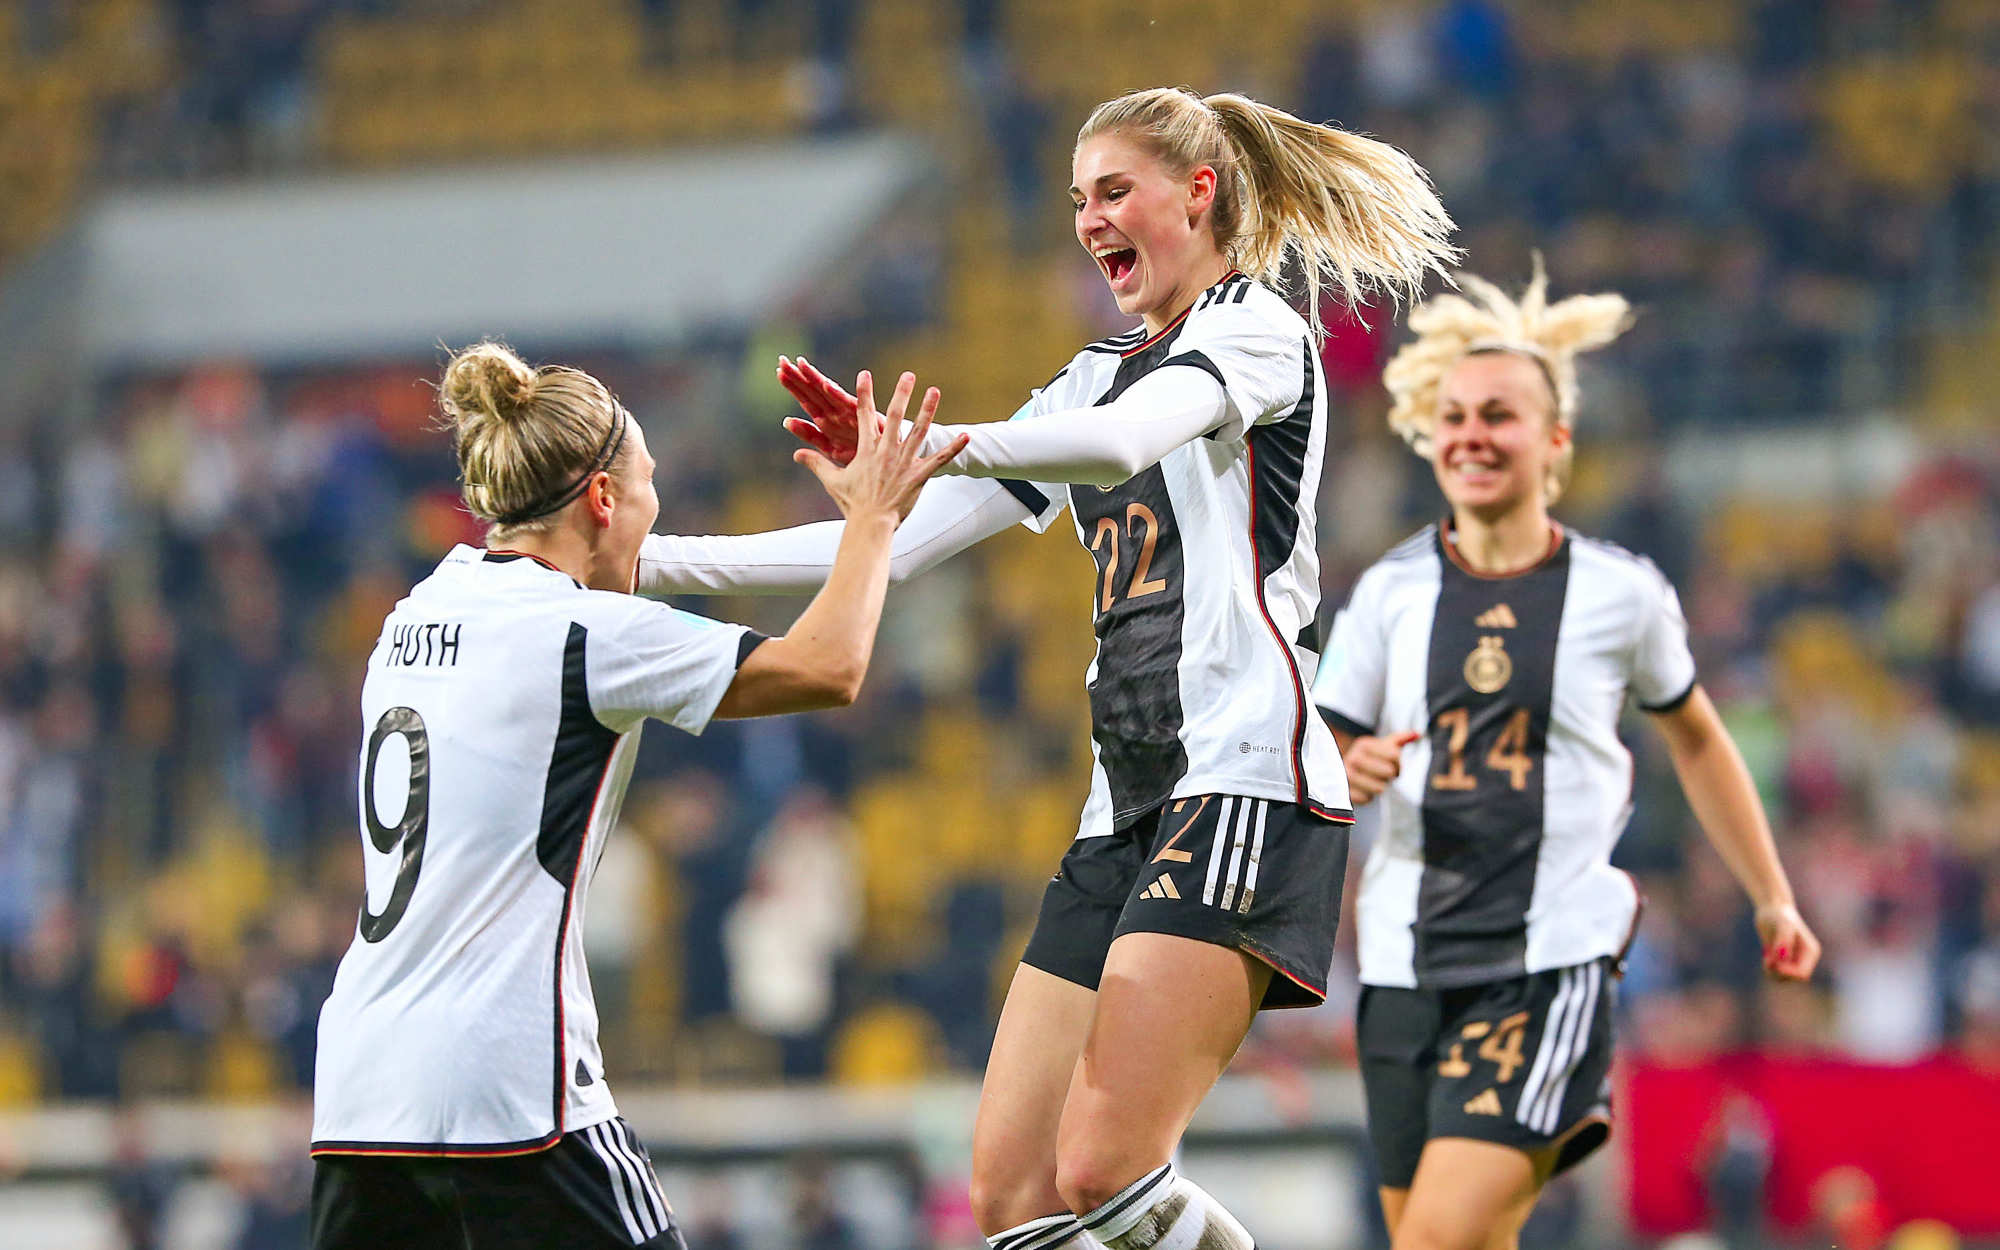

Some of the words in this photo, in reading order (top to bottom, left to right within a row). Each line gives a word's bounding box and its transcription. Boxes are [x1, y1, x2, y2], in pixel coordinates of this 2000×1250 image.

[1091, 503, 1166, 613] 22
[386, 623, 462, 667] HUTH
[1431, 708, 1533, 791] 14
[360, 706, 430, 943] 9
[1438, 1011, 1530, 1084] 14
